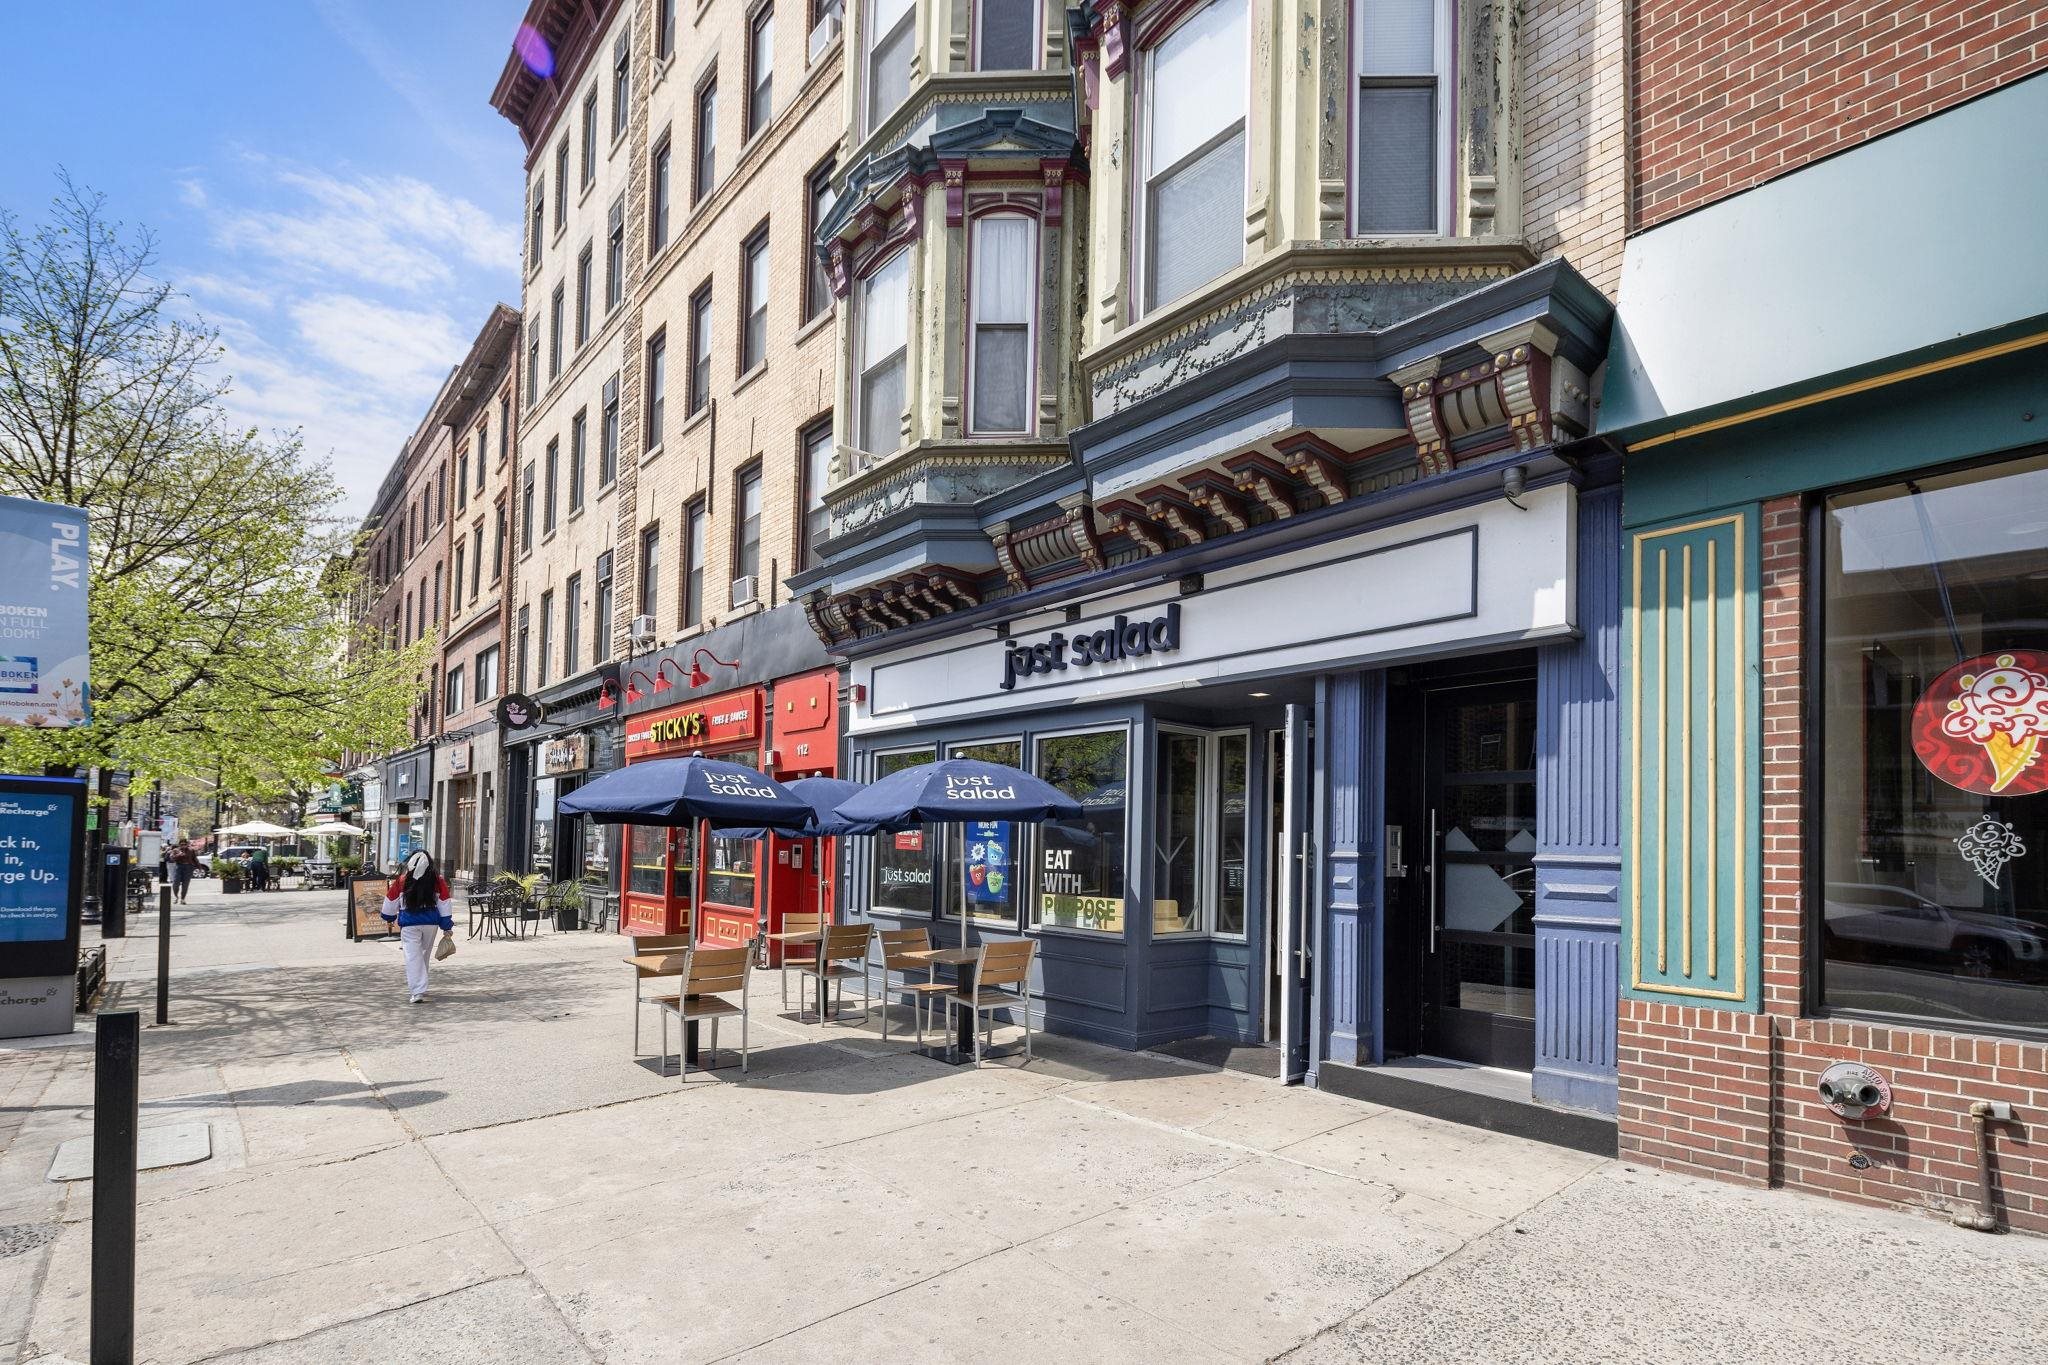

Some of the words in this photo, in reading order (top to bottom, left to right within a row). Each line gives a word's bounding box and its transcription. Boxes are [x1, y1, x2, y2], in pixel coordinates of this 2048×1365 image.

[51, 521, 80, 592] PLAY.
[11, 617, 49, 629] FULL
[1000, 632, 1069, 690] just
[1071, 602, 1182, 667] salad
[650, 712, 701, 743] STICKY'S
[796, 743, 809, 756] 112
[701, 769, 752, 784] just
[945, 774, 994, 789] just
[708, 783, 778, 799] salad
[946, 785, 1016, 800] salad
[0, 807, 50, 817] Recharge
[21, 836, 41, 851] in,
[4, 852, 24, 867] in,
[1044, 849, 1073, 870] EAT
[30, 869, 60, 884] Up.
[884, 866, 903, 884] just
[903, 868, 931, 884] salad
[1043, 872, 1082, 895] WITH
